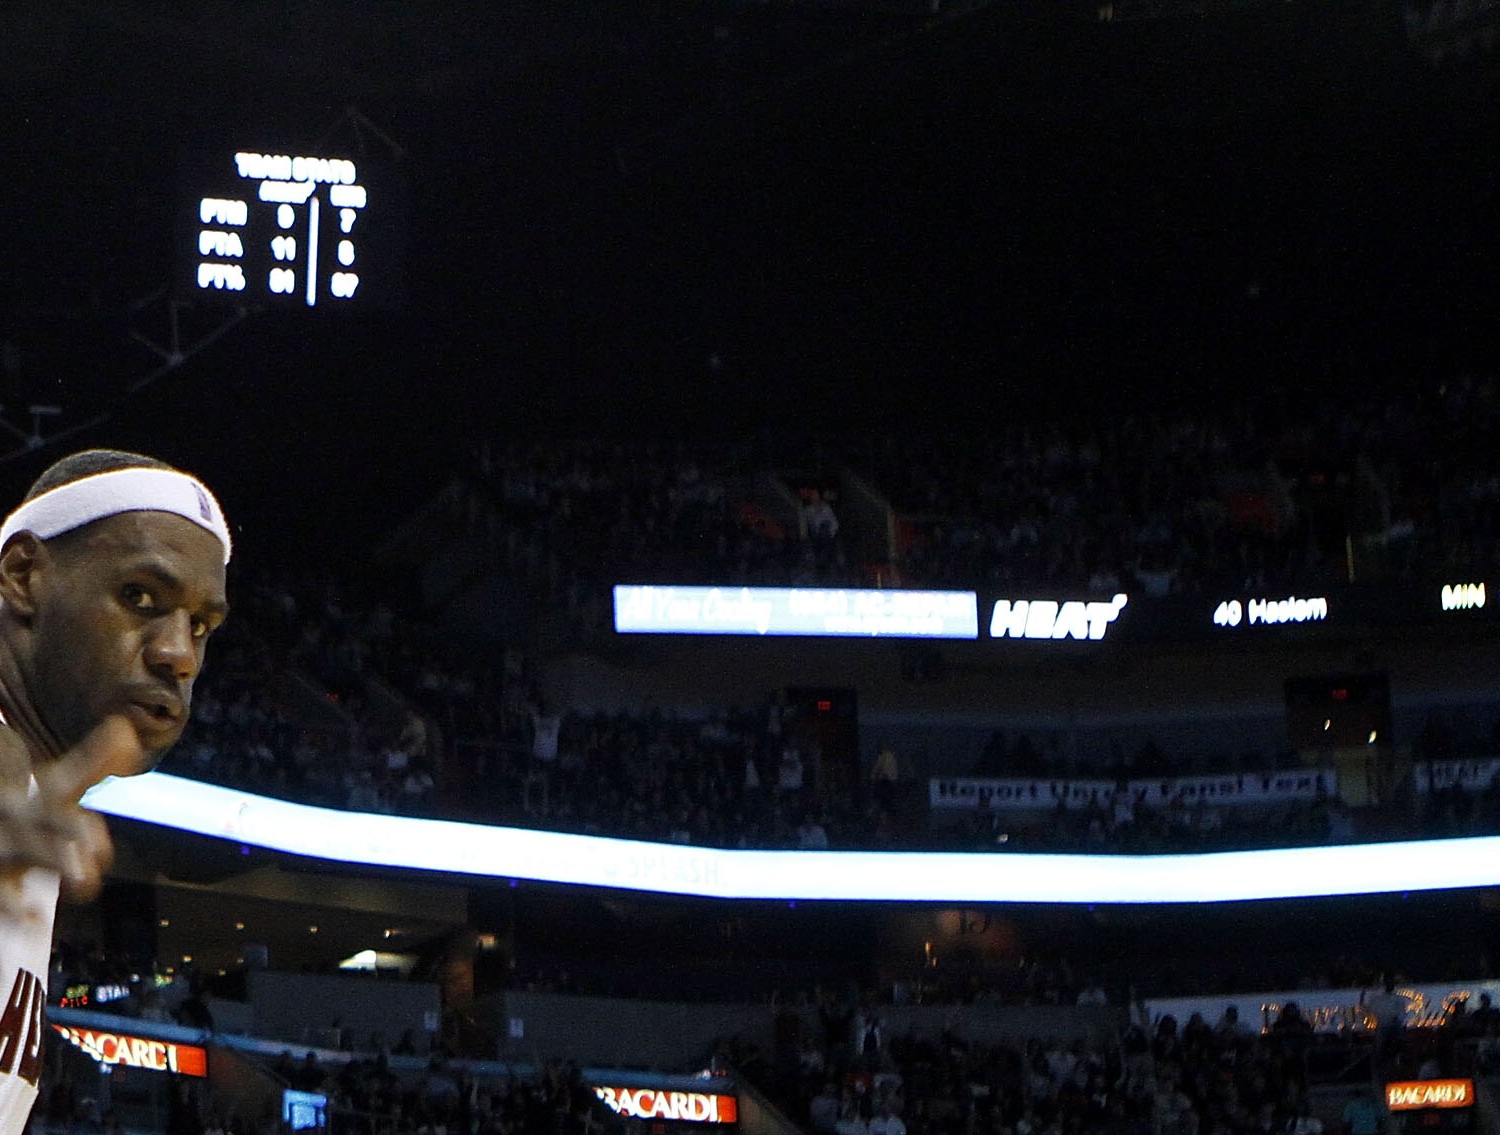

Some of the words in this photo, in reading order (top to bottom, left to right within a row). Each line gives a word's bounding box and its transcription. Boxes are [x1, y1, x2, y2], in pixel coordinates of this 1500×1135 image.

[1442, 582, 1485, 610] MIN
[991, 593, 1127, 638] HEAT
[1213, 600, 1242, 627] 40
[1388, 1083, 1466, 1106] BACARDI
